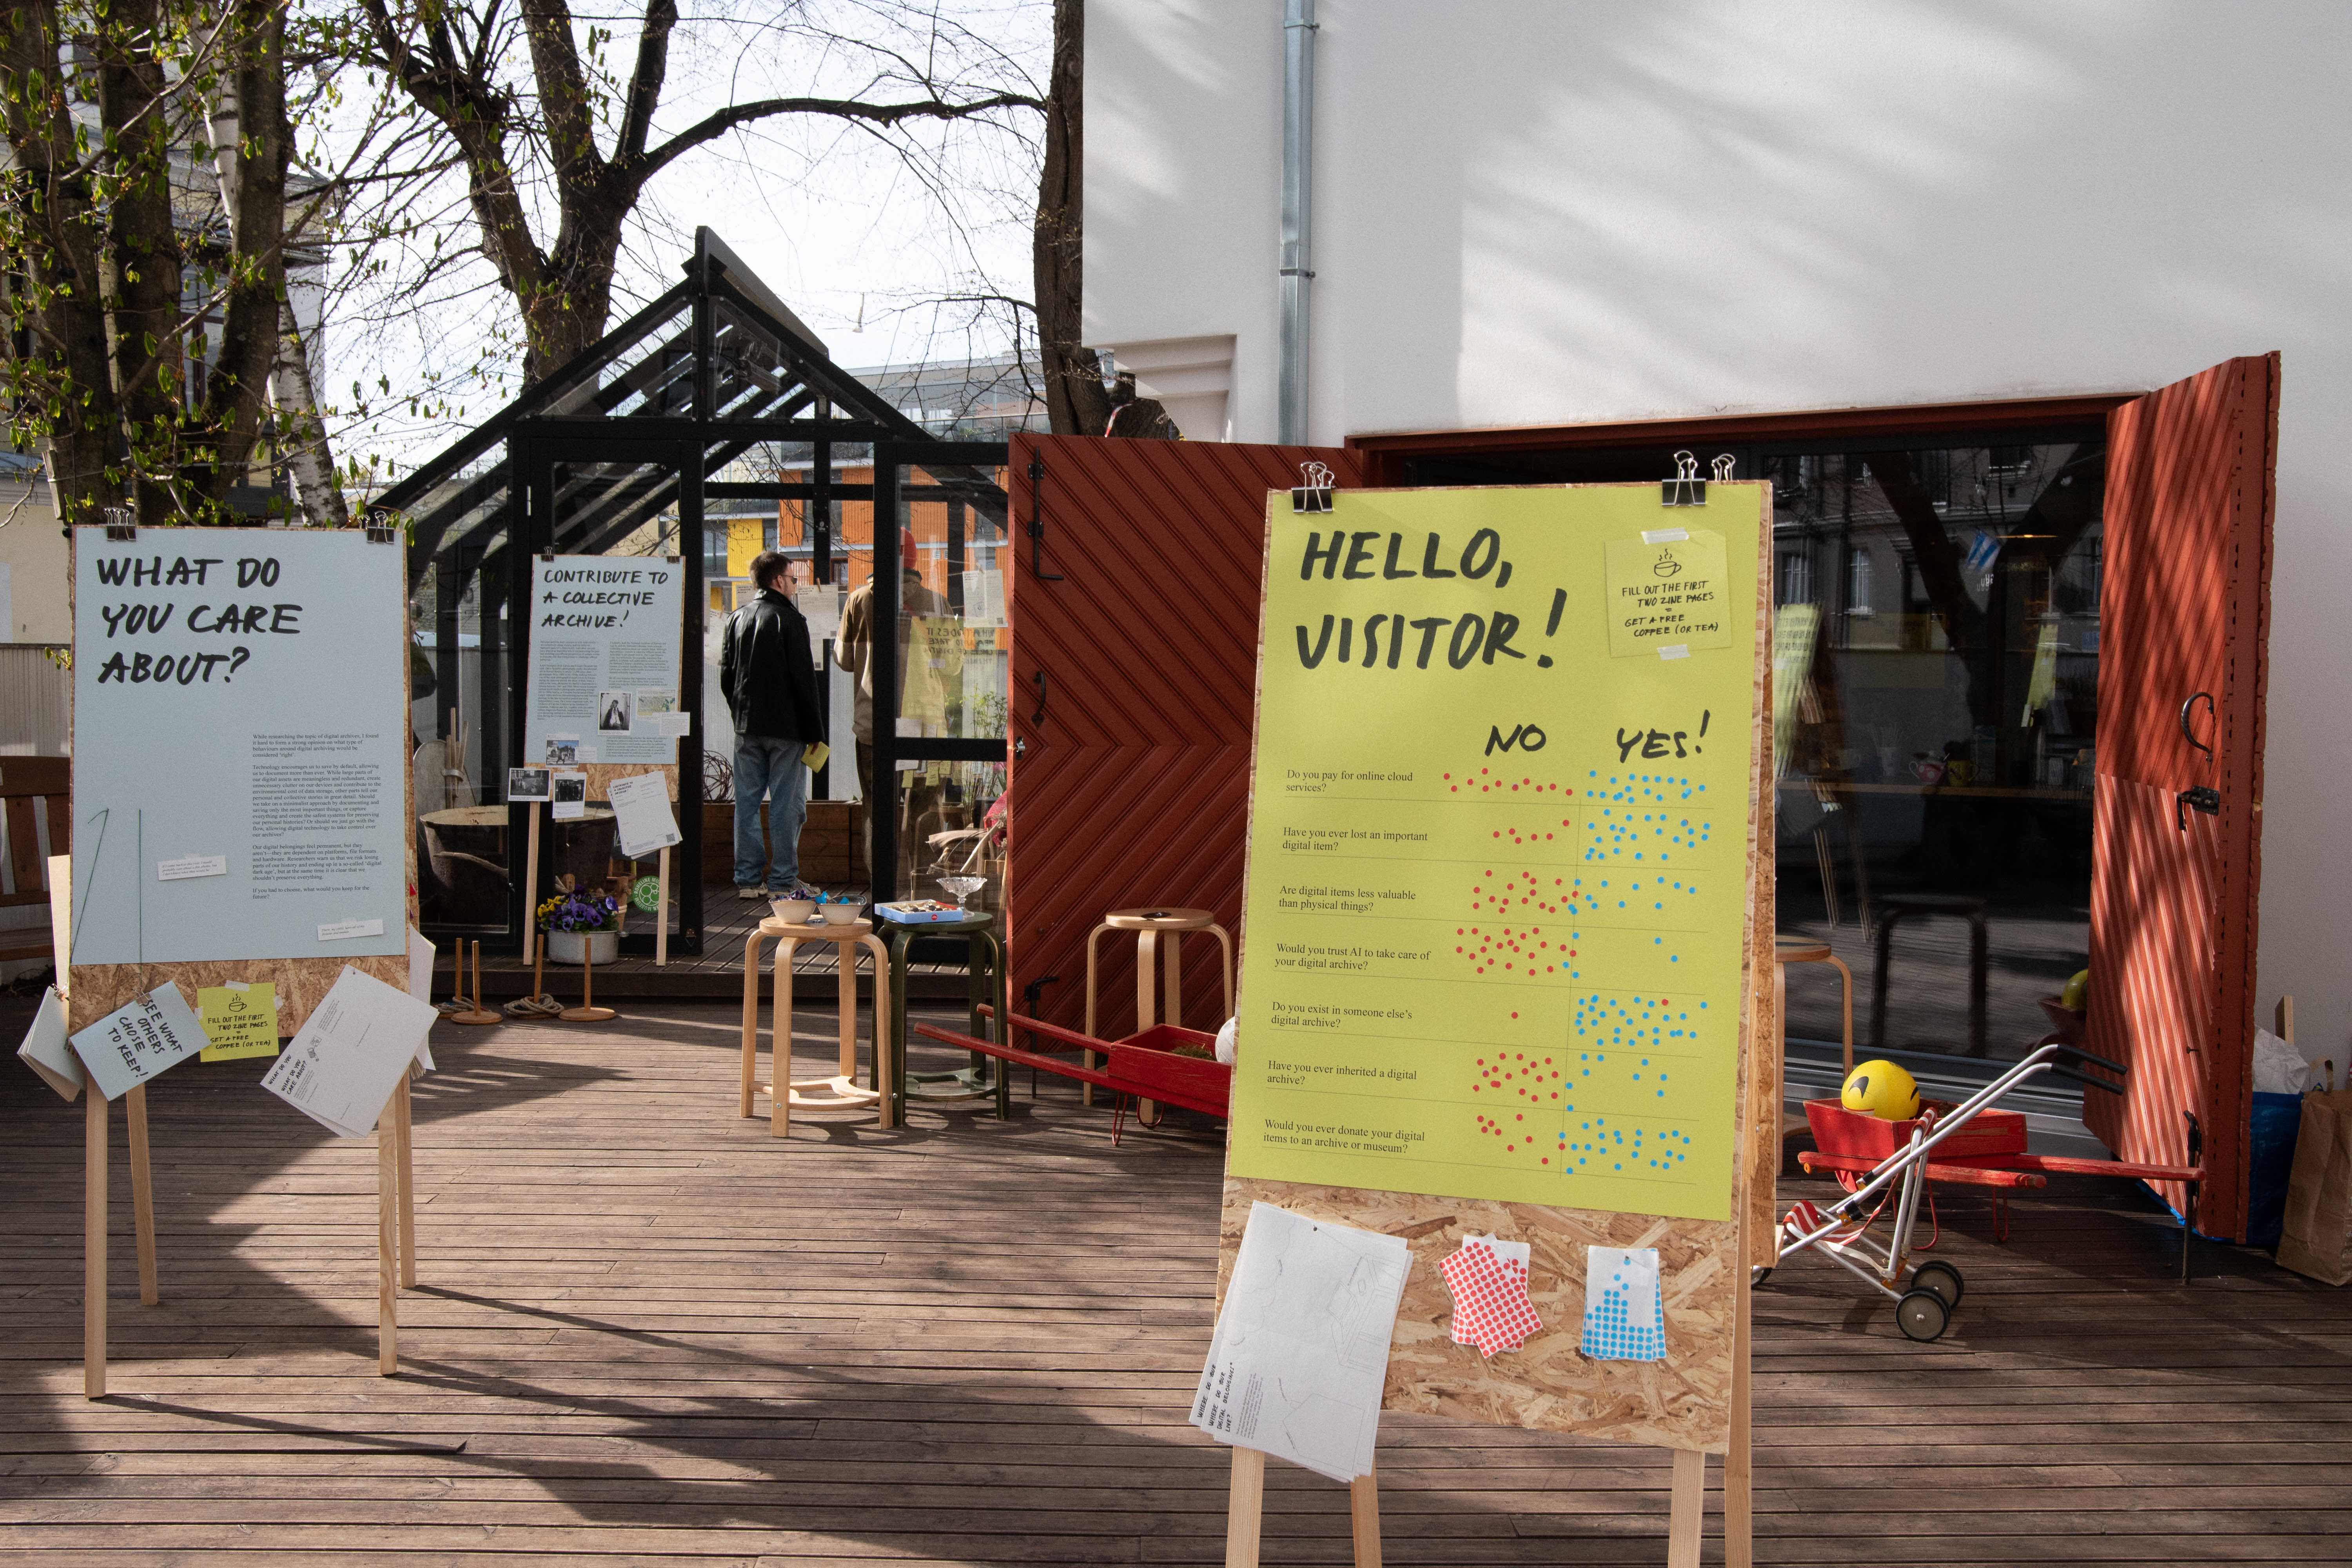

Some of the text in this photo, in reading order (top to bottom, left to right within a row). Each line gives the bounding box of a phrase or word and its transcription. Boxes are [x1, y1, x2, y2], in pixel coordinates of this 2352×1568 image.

[1301, 528, 1512, 588] HELLO,
[97, 556, 280, 588] WHAT DO
[544, 570, 668, 584] CONTRIBUTE TO
[1622, 581, 1708, 597] FILL OUT THE FIRST
[543, 592, 654, 606] A COLLECTIVE
[1638, 592, 1713, 607] TWO ZINE PAGES
[102, 603, 303, 638] YOU CARE
[541, 610, 629, 628] ARCHIVE!
[1625, 617, 1646, 627] GET
[1296, 588, 1567, 670] VISITOR!
[1634, 622, 1718, 637] COFFEE (OR TEA)
[98, 646, 250, 685] ABOUT?
[1485, 724, 1546, 757] NO
[1617, 710, 1710, 763] YES!
[1322, 773, 1338, 781] pay
[1341, 771, 1354, 779] for
[1357, 771, 1385, 780] online
[1388, 772, 1412, 781] cloud
[1287, 783, 1326, 792] services?
[1284, 828, 1306, 836] Have
[1309, 831, 1325, 839] you
[1351, 829, 1366, 838] lost
[1384, 833, 1427, 842] important
[1283, 840, 1338, 851] digital item?
[1280, 886, 1416, 899] Are digital items less valuable
[634, 897, 650, 911] MUSEUM
[1279, 898, 1373, 913] than physical things?
[1277, 944, 1305, 953] Would
[1308, 947, 1324, 956] you
[1350, 948, 1361, 956] AI
[1377, 949, 1395, 958] take
[1420, 951, 1431, 960] of
[1275, 958, 1368, 970] your digital archive?
[1273, 1002, 1285, 1011] Do
[1288, 1005, 1305, 1014] you
[1308, 1005, 1328, 1014] exist
[1332, 1005, 1340, 1014] in
[141, 999, 182, 1052] SEE WHAT
[1271, 1015, 1340, 1027] digital archive?
[119, 1017, 149, 1052] CHOSE
[134, 1018, 170, 1054] OTHERS
[108, 1027, 148, 1077] TO KEEP!
[269, 1071, 279, 1084] WHAT
[287, 1080, 296, 1094] CARE
[296, 1060, 306, 1079] ABOUT?
[1269, 1060, 1291, 1070] Have
[1294, 1065, 1310, 1073] you
[1337, 1065, 1376, 1076] inherited
[1387, 1069, 1416, 1081] digital
[281, 1076, 290, 1091] WHAT
[1267, 1075, 1305, 1084] archive?
[1265, 1119, 1293, 1130] Would
[1296, 1124, 1312, 1133] you
[1338, 1125, 1368, 1136] donate
[1371, 1131, 1392, 1139] your
[1396, 1130, 1424, 1142] digital
[1264, 1132, 1287, 1143] items
[1315, 1138, 1348, 1148] archive
[1364, 1144, 1407, 1153] museum?
[1197, 1396, 1208, 1418] WHERE
[1206, 1382, 1211, 1391] DO
[1208, 1404, 1218, 1426] WHERE
[1217, 1409, 1225, 1429] DIGITAL
